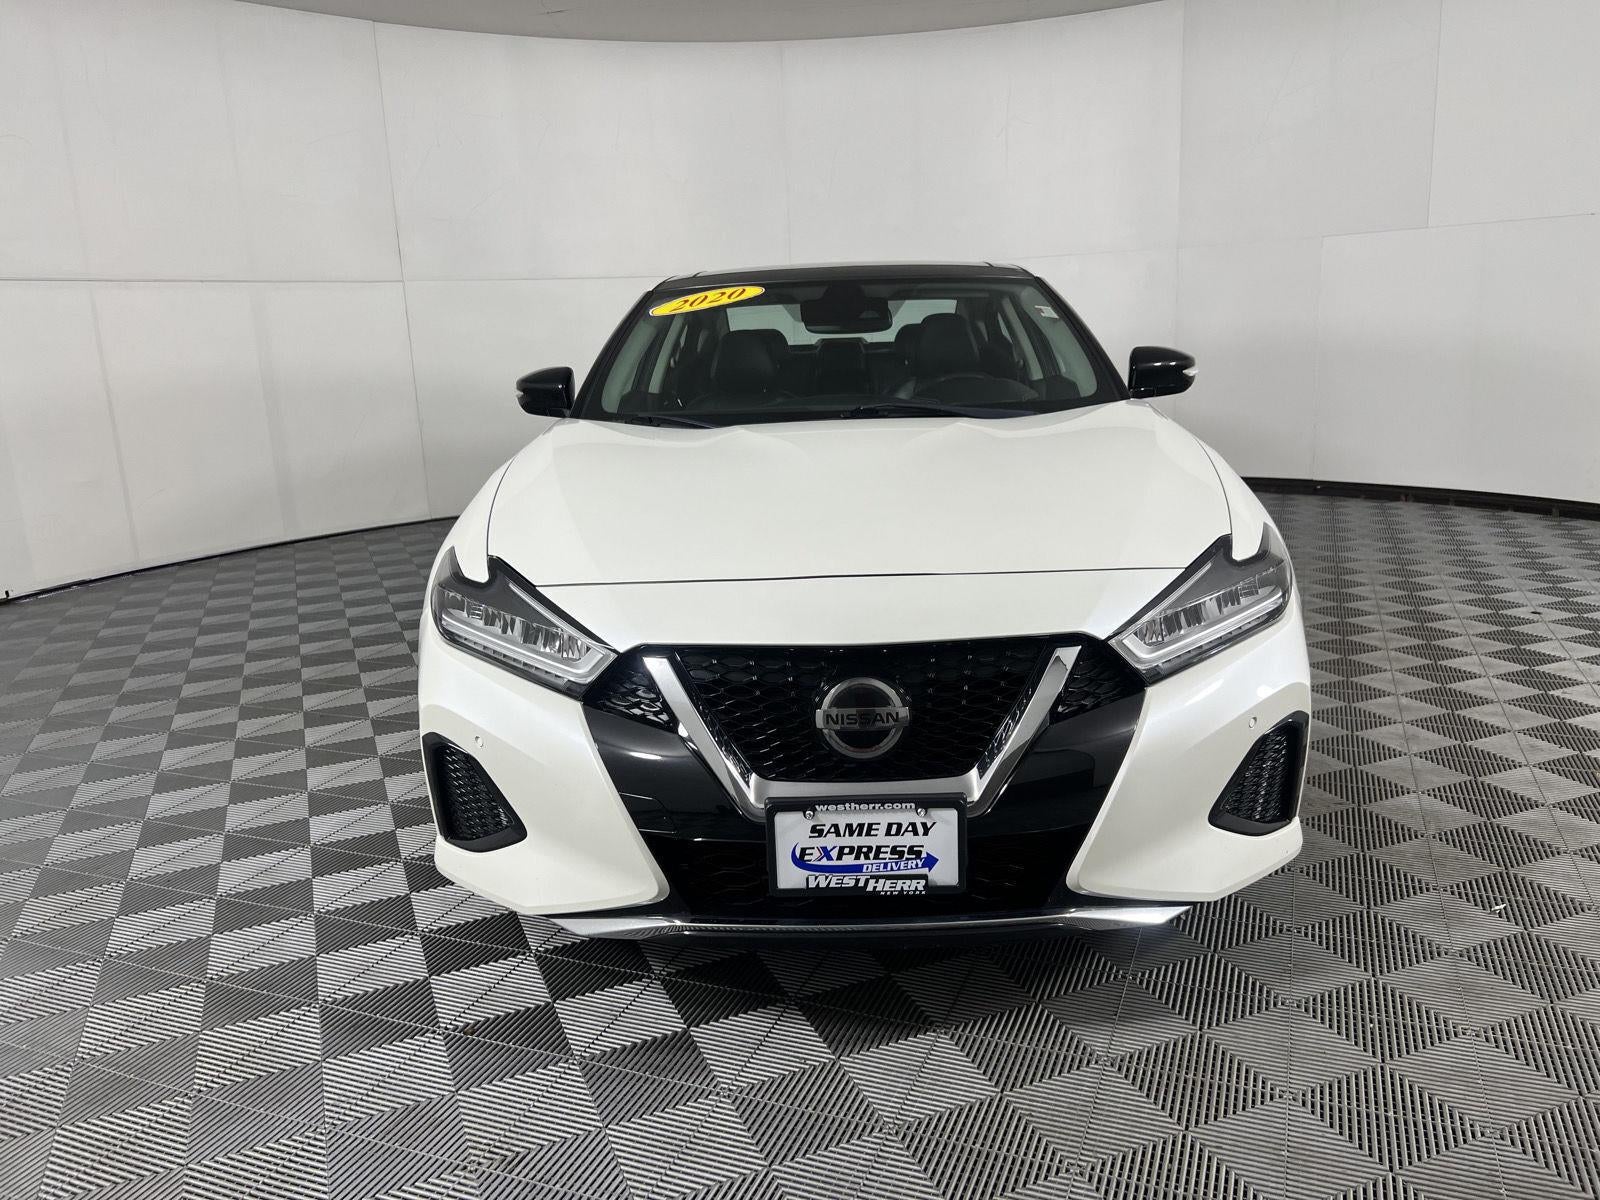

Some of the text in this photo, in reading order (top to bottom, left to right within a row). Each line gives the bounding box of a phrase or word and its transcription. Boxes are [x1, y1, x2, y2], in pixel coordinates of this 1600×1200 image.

[669, 288, 746, 312] 2020
[825, 711, 899, 726] NISSAN
[815, 802, 915, 812] westherr.com
[808, 821, 937, 839] SAME DAY
[799, 844, 924, 863] EXPRESS
[862, 858, 925, 873] DELIVERY
